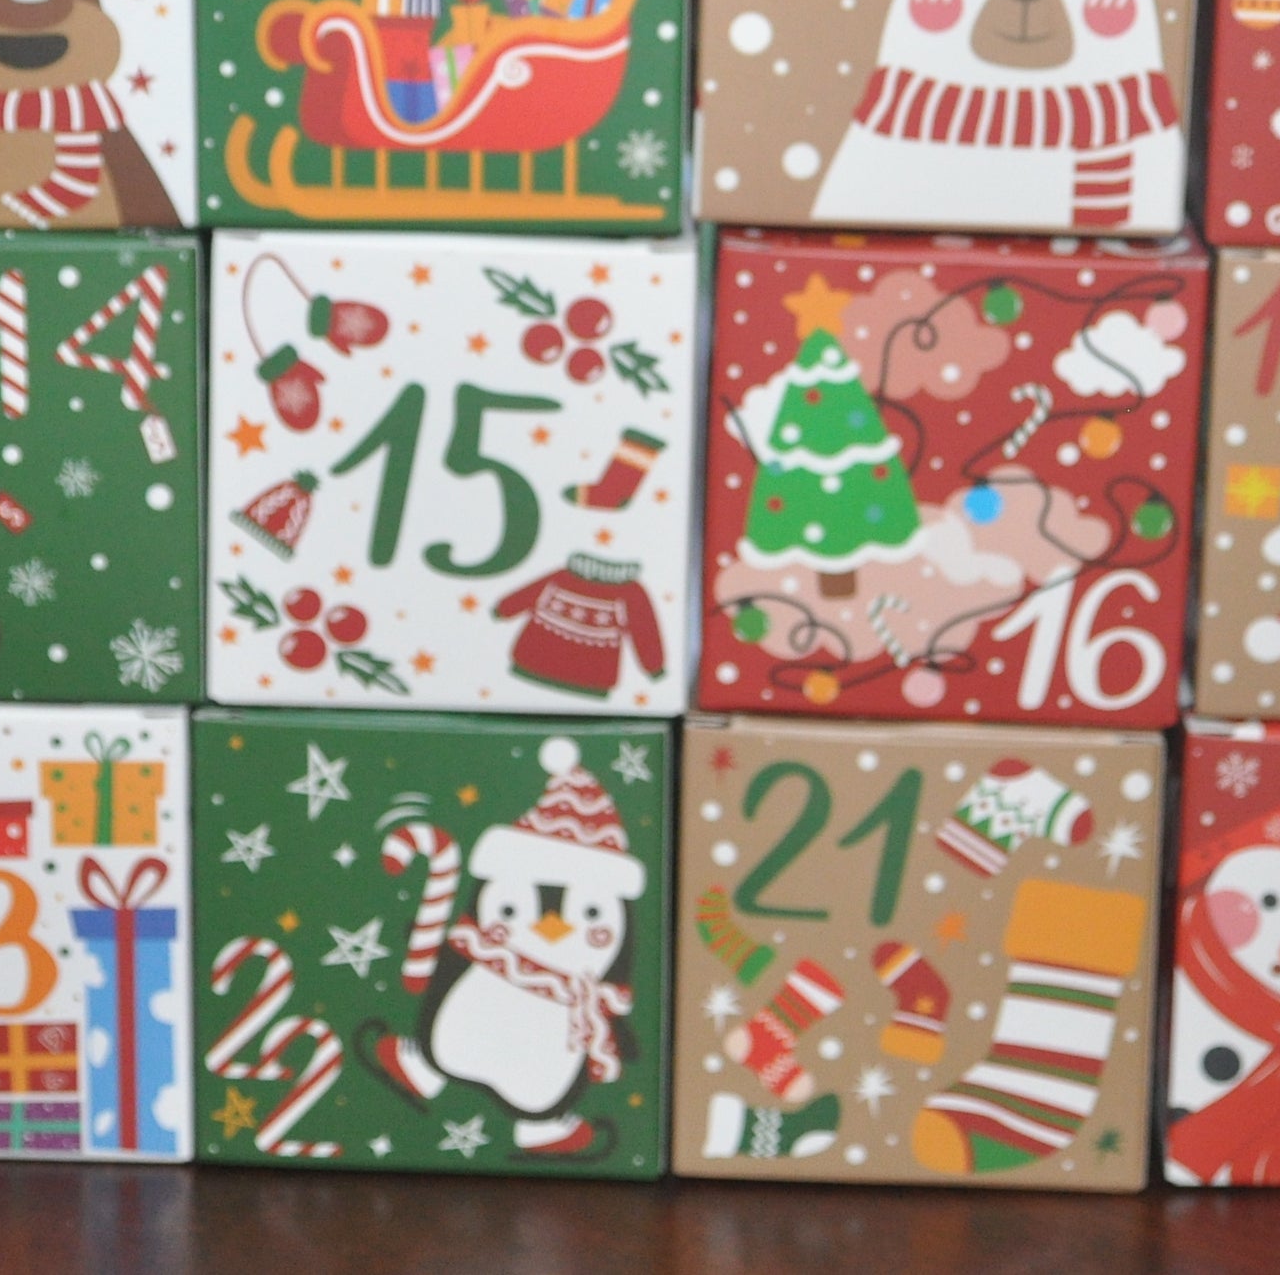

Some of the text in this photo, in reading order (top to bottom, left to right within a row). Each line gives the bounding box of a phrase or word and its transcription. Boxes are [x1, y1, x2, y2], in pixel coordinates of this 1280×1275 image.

[329, 381, 562, 578] 15
[991, 566, 1167, 712] 16
[733, 755, 923, 927] 21
[206, 936, 343, 1159] 22
